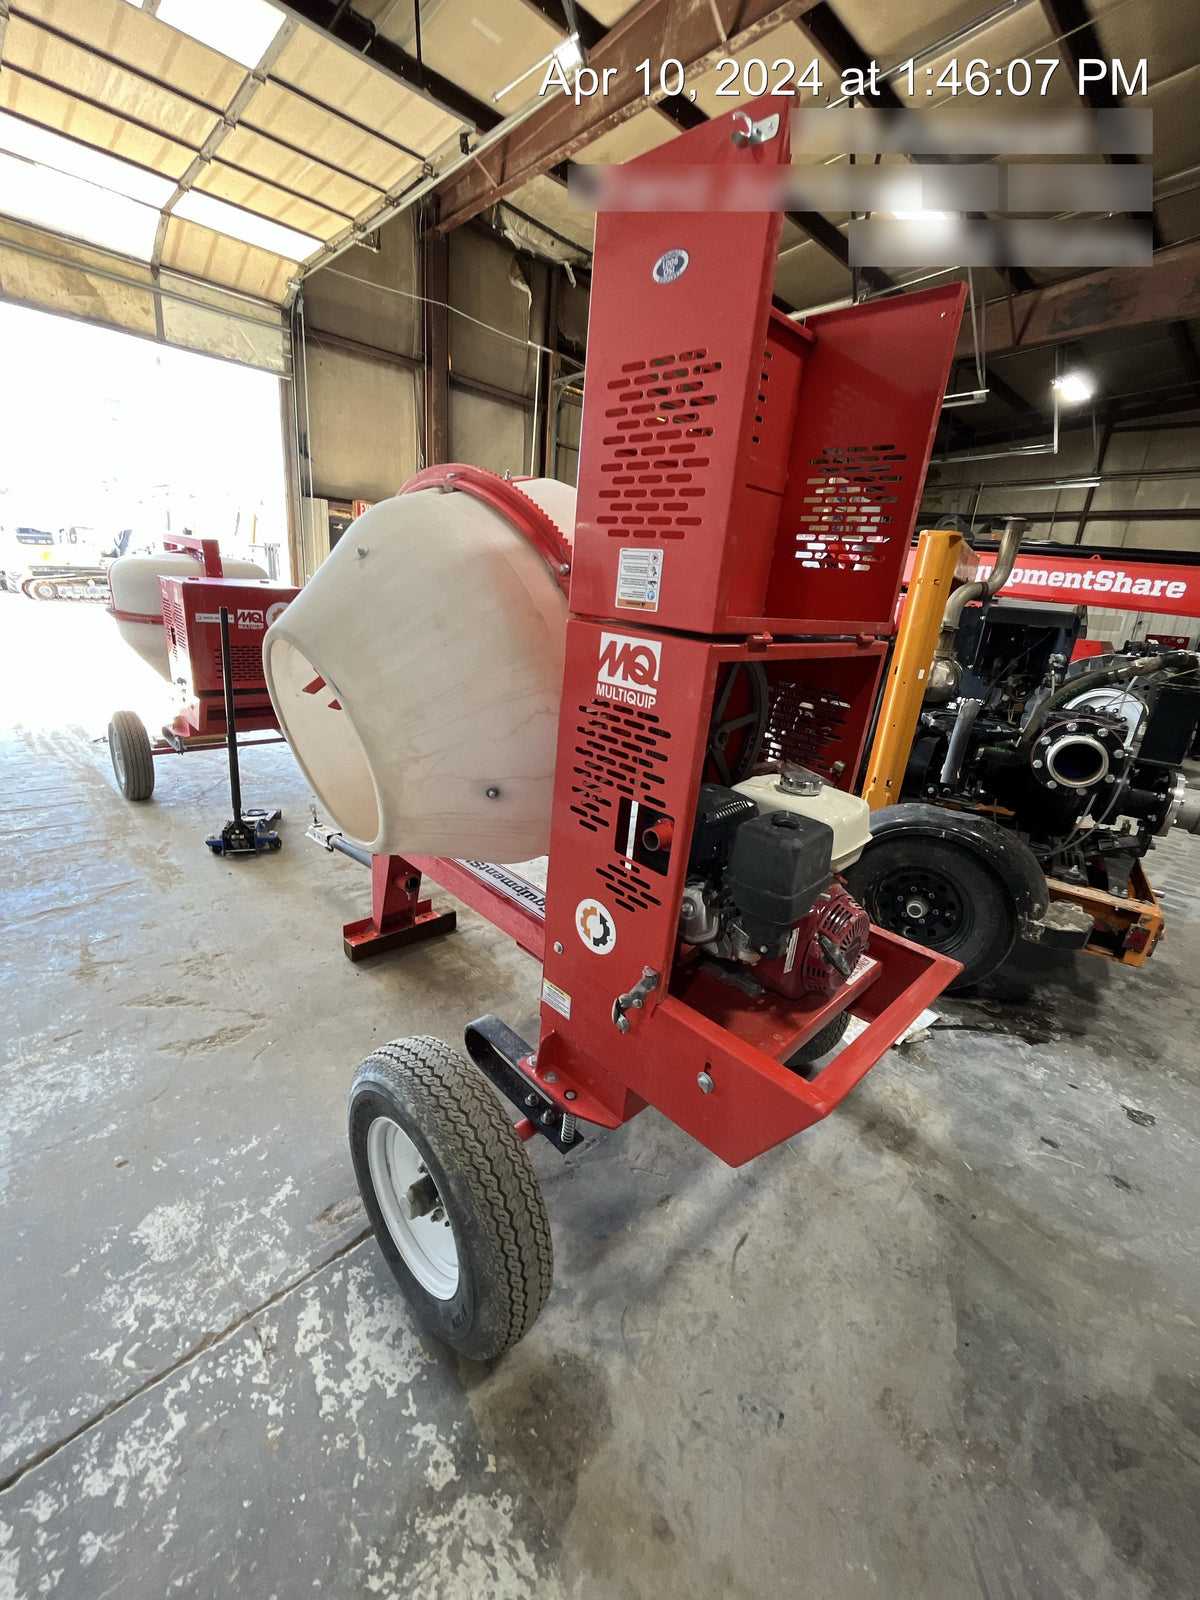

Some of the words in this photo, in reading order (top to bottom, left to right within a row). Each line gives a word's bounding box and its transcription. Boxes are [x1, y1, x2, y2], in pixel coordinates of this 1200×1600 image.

[598, 639, 660, 690] MQ
[596, 682, 657, 710] MULTIQUIP
[465, 859, 546, 914] quipmentS
